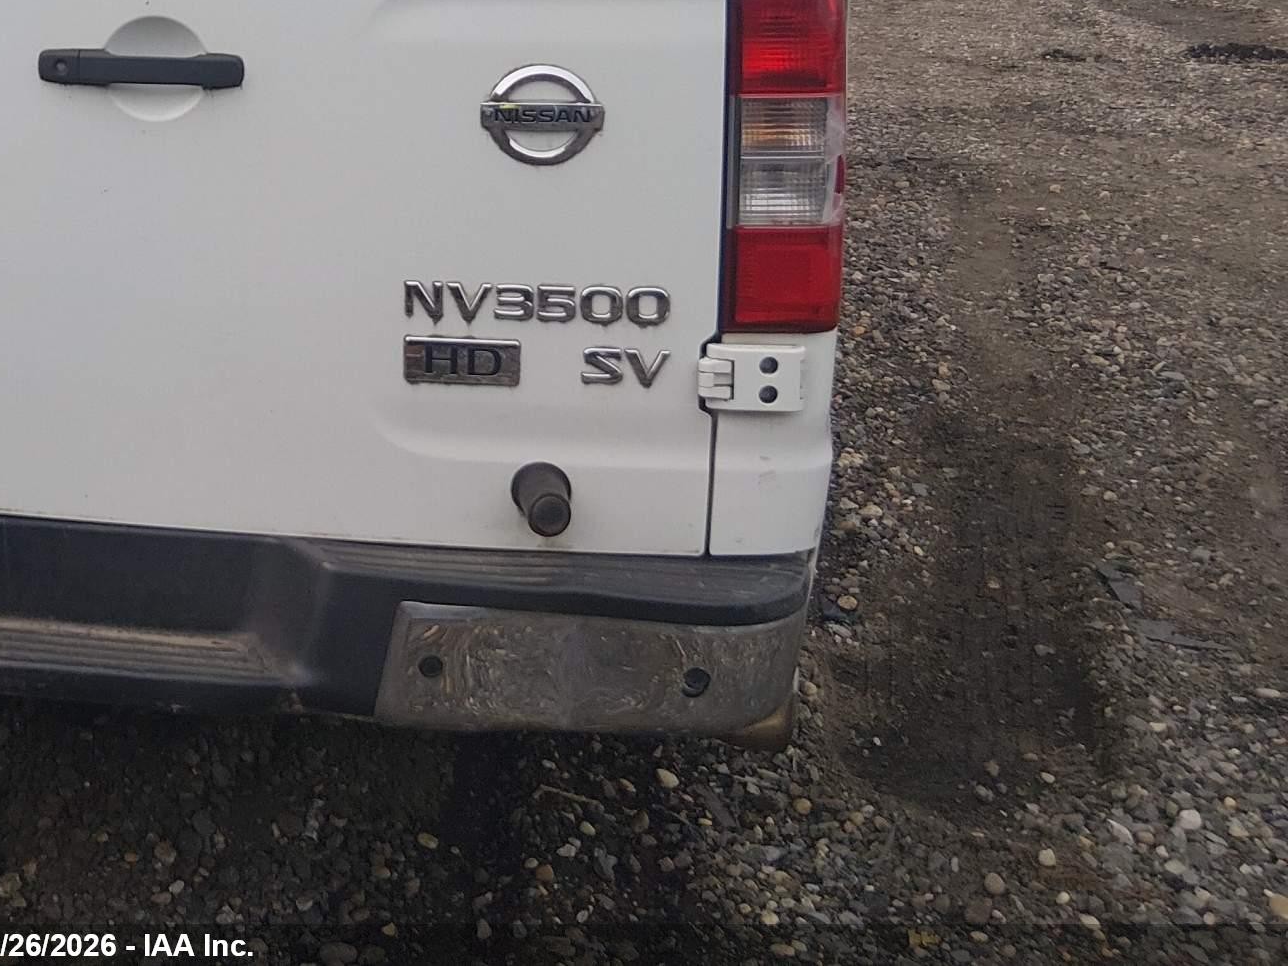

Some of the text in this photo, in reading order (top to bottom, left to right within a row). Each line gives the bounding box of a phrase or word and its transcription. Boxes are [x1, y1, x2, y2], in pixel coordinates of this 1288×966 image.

[493, 106, 592, 124] NISSAN
[404, 280, 671, 326] NV3500
[423, 343, 503, 376] HD
[580, 346, 671, 388] SV
